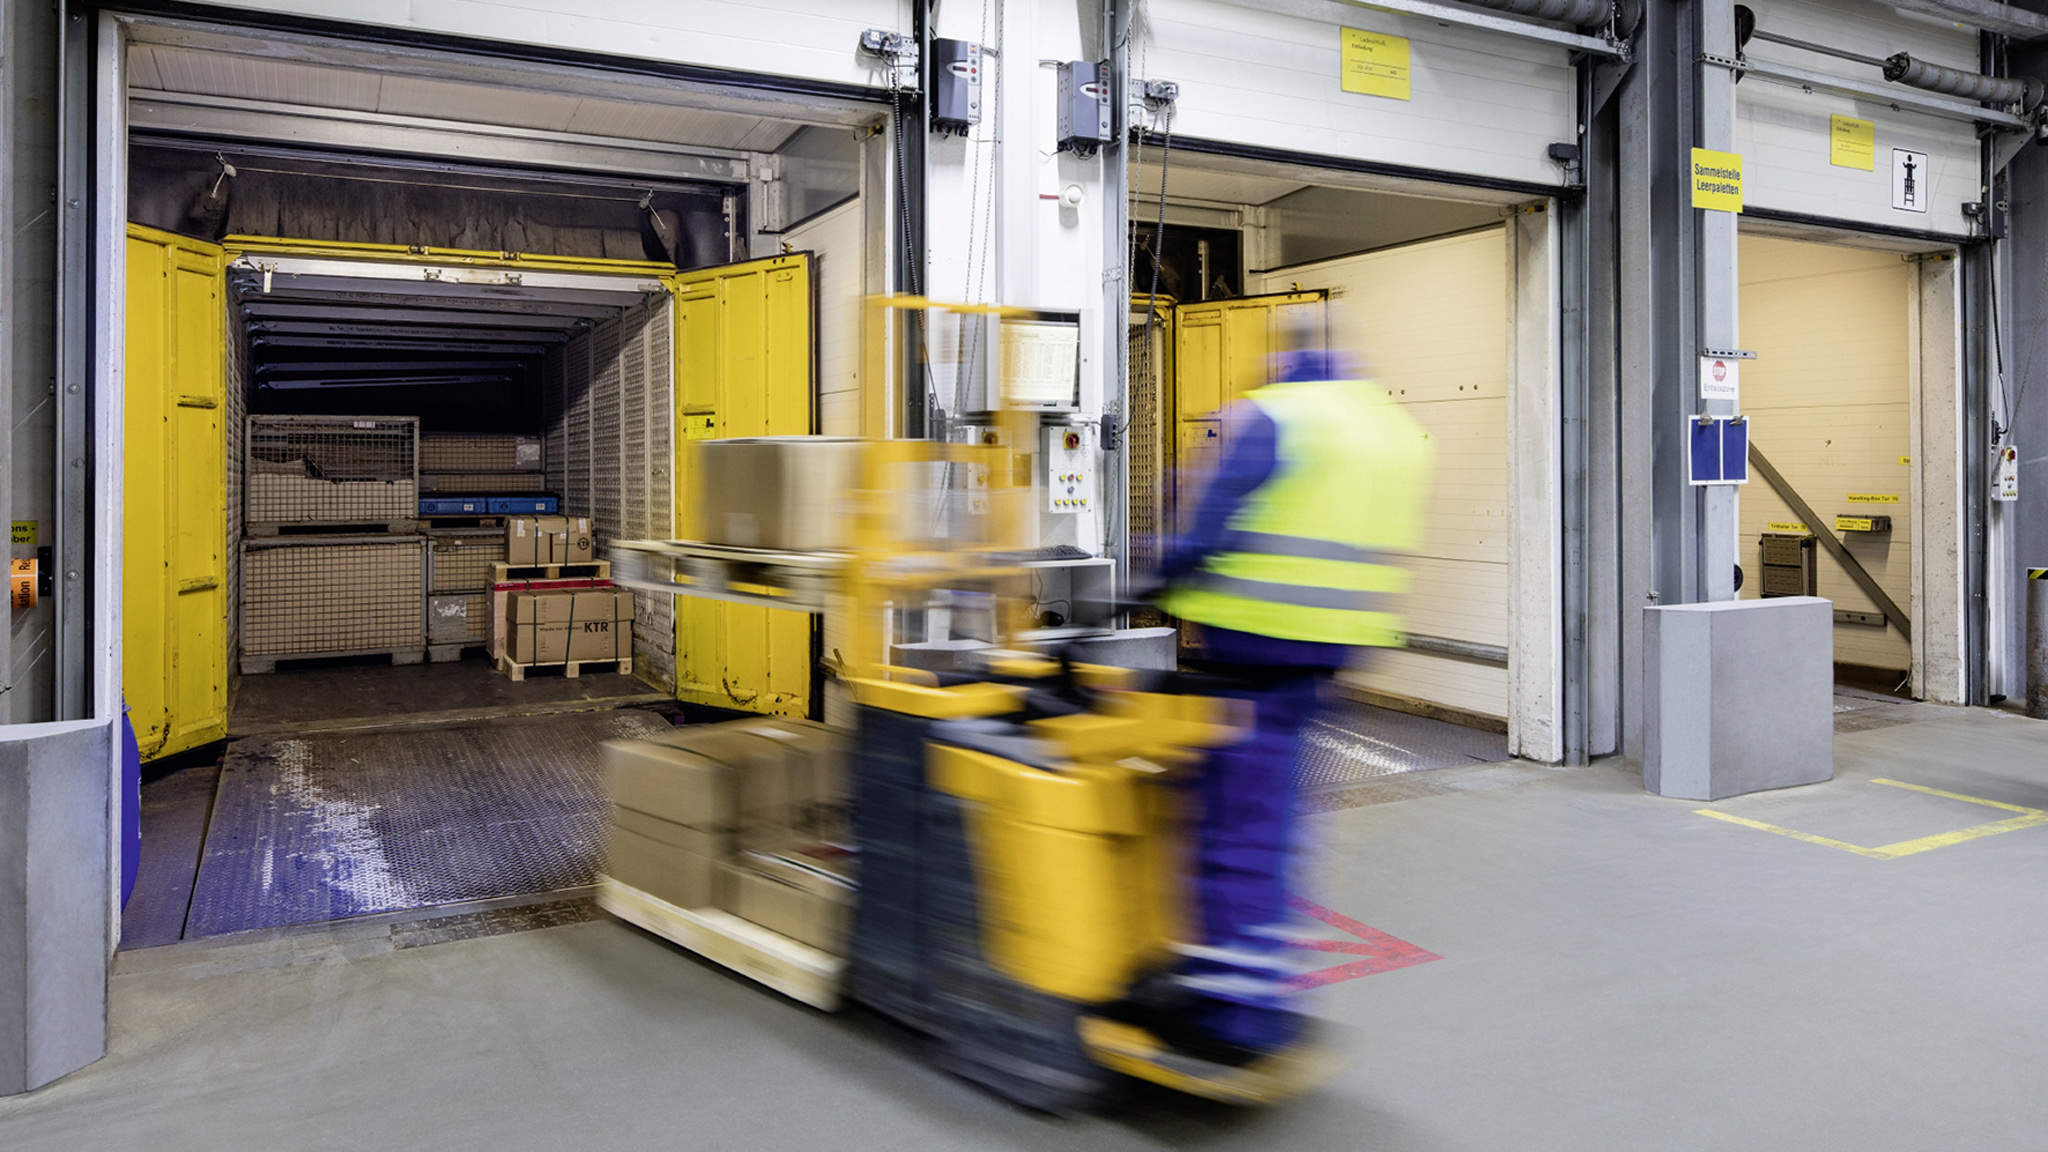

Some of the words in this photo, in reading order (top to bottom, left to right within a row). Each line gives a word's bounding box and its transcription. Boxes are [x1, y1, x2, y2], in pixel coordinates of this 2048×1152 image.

[1695, 162, 1740, 181] Sammelstelle
[1696, 179, 1739, 195] Leerpaletten
[584, 622, 608, 632] KTR
